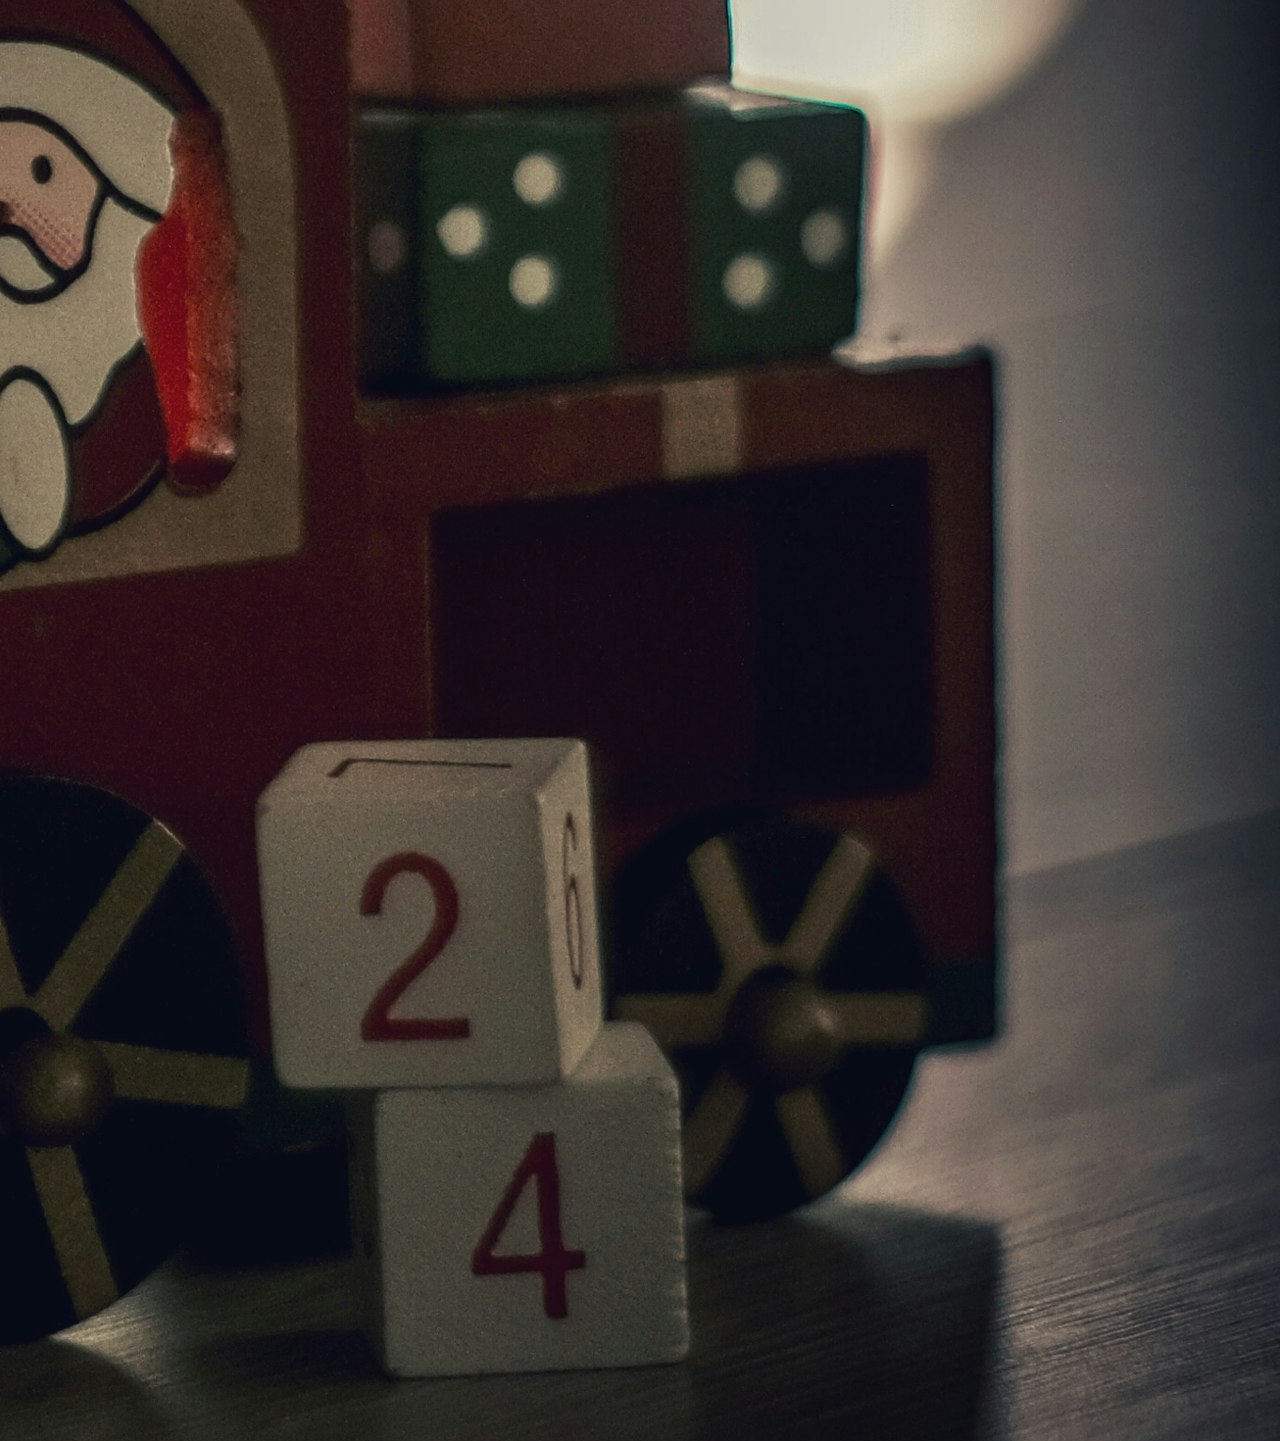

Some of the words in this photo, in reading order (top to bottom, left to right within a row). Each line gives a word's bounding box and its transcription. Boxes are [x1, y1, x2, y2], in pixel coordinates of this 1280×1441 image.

[360, 852, 470, 1042] 2
[561, 811, 583, 990] 6
[471, 1132, 587, 1319] 4
